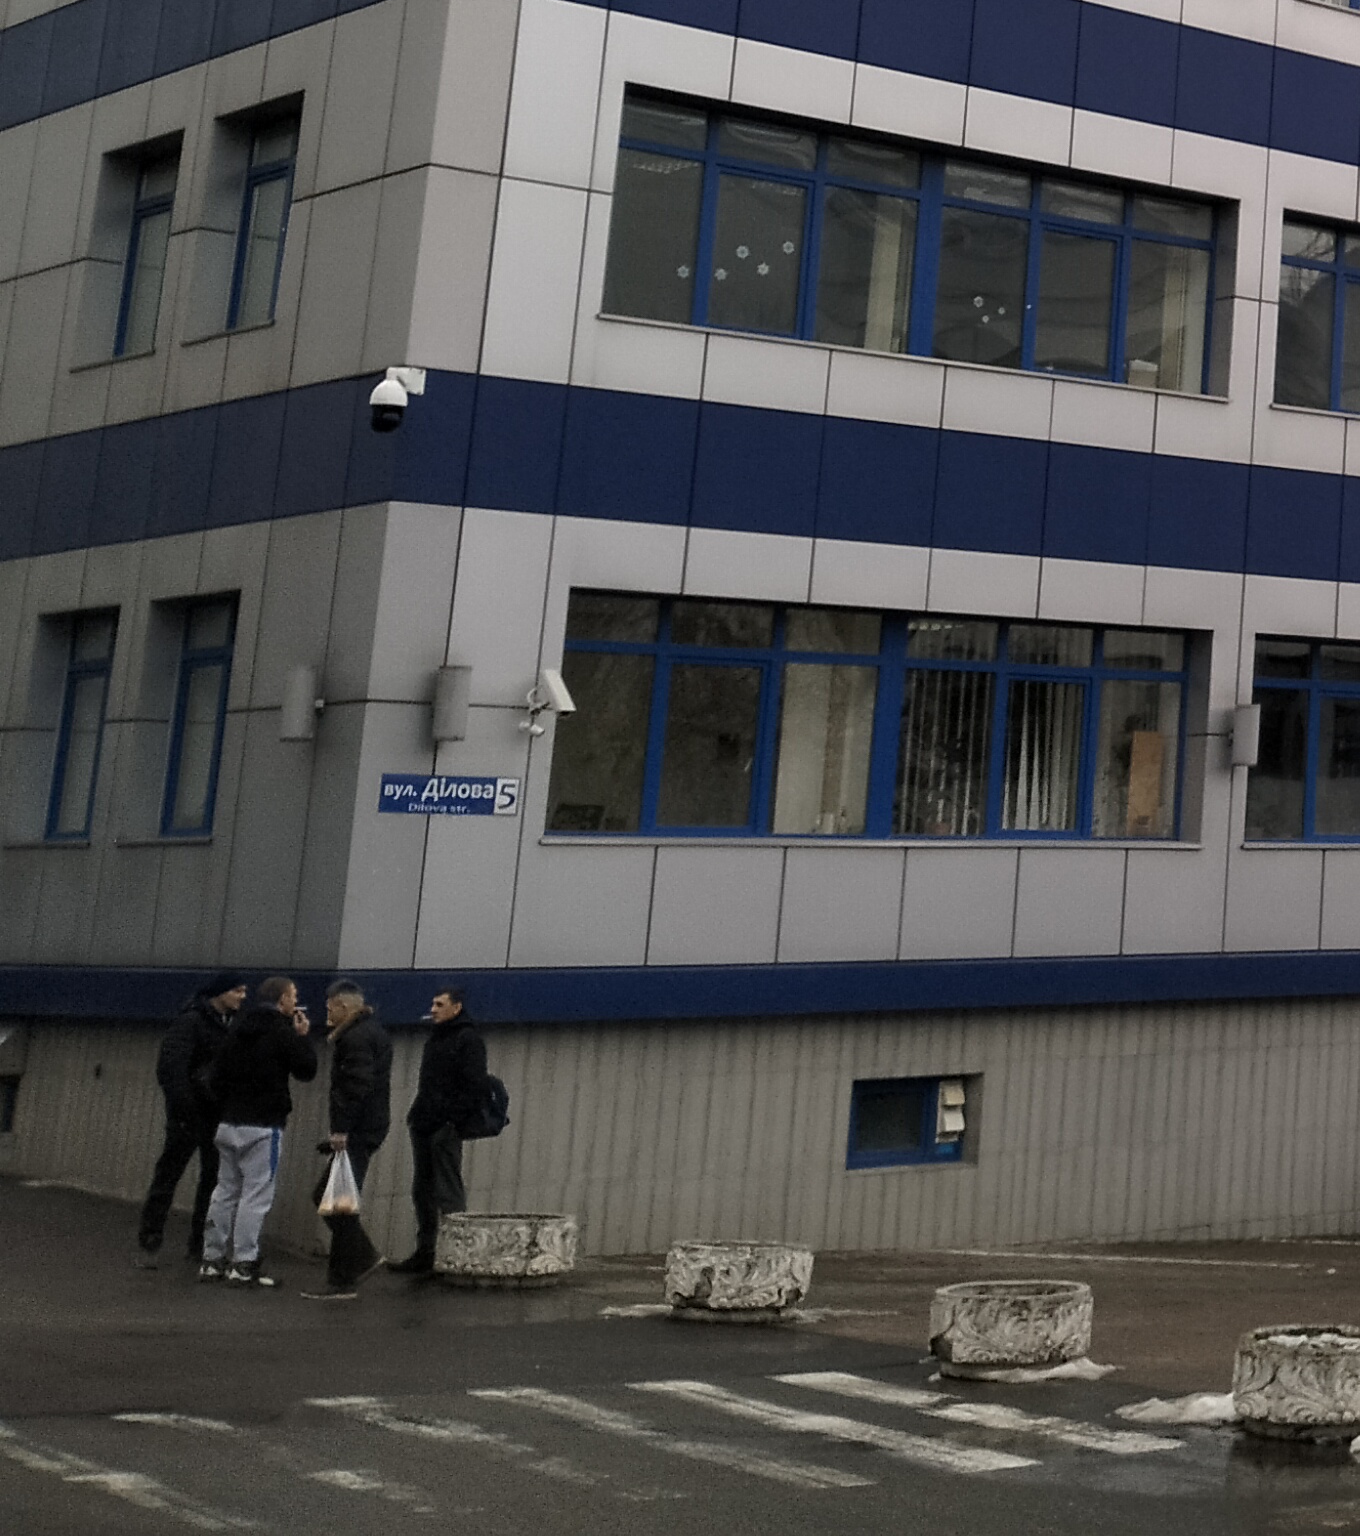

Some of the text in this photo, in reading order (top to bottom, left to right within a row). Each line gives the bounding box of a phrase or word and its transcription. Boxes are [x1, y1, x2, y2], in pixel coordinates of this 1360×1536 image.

[384, 777, 495, 802] вул. Ділова
[498, 783, 516, 809] 5
